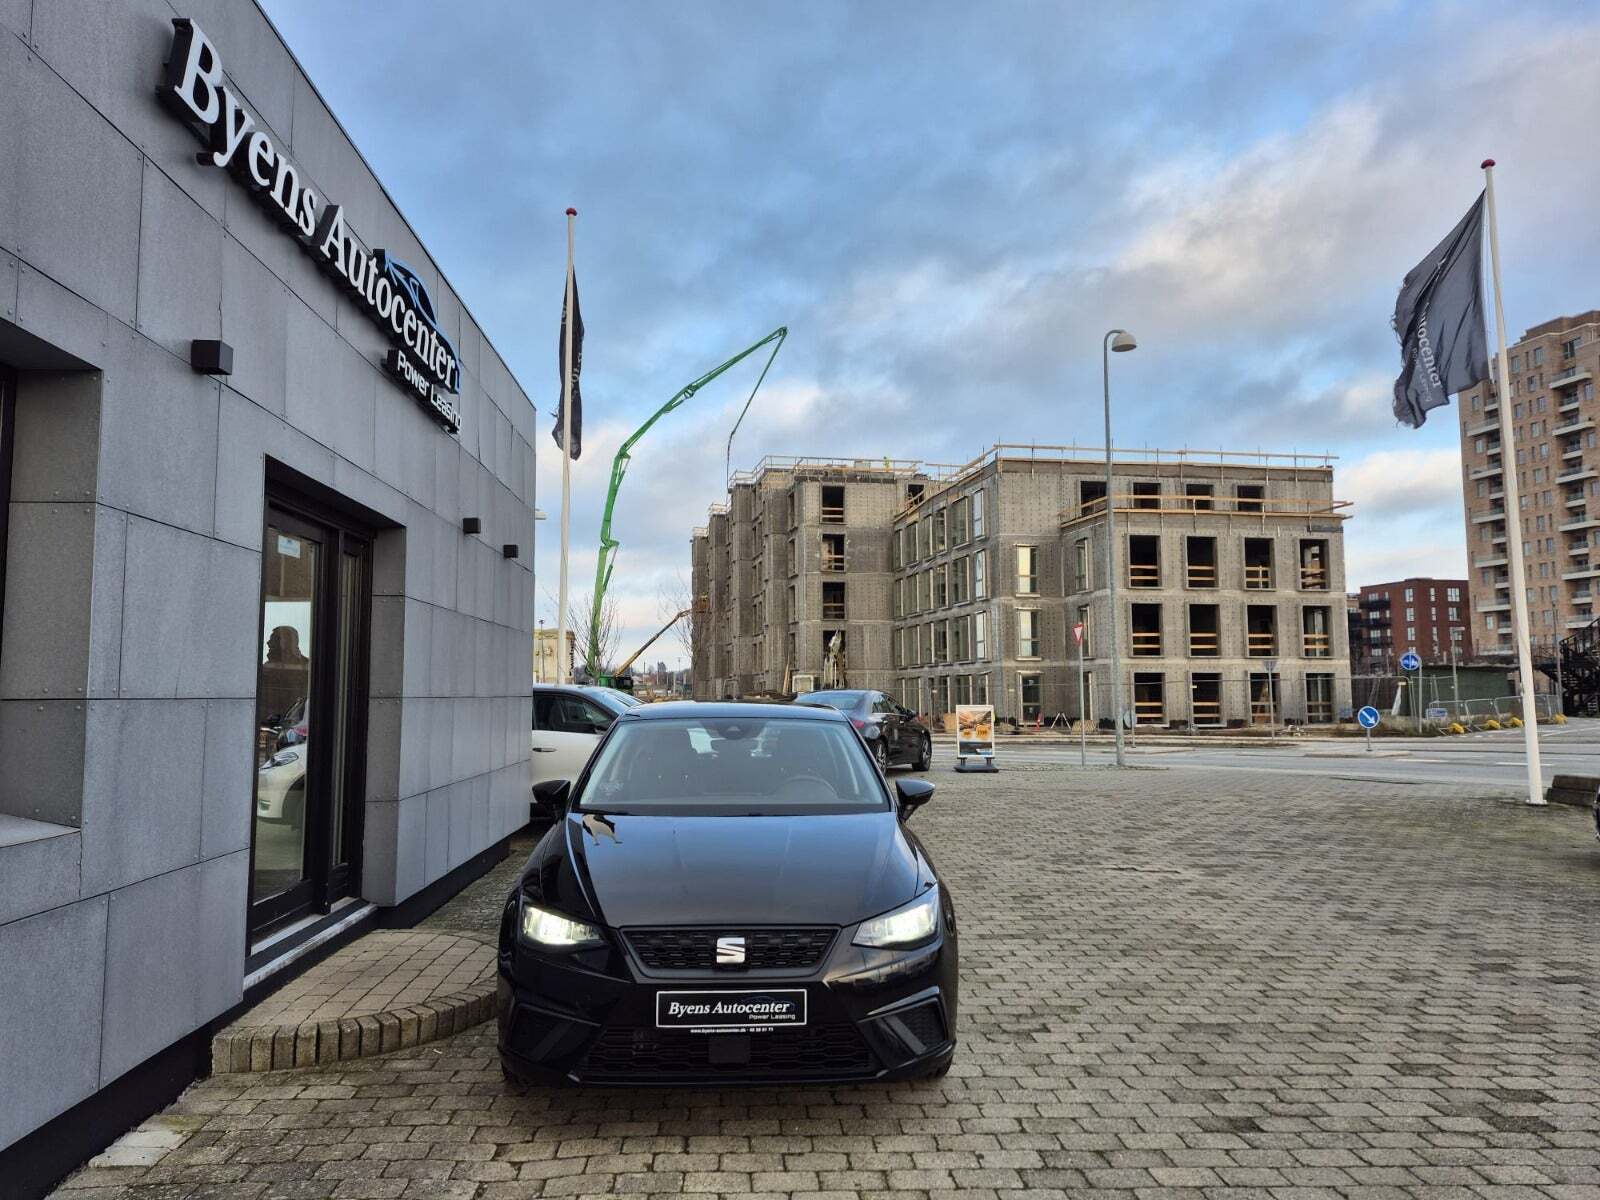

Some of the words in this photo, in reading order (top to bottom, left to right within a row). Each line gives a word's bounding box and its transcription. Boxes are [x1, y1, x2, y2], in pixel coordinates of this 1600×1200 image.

[173, 17, 320, 237] Byens
[320, 205, 457, 390] Autocenter
[397, 349, 430, 397] Power
[431, 384, 462, 434] Leasing
[668, 1001, 711, 1018] Byens
[712, 1001, 790, 1015] Autocenter
[771, 1013, 796, 1021] Leasing
